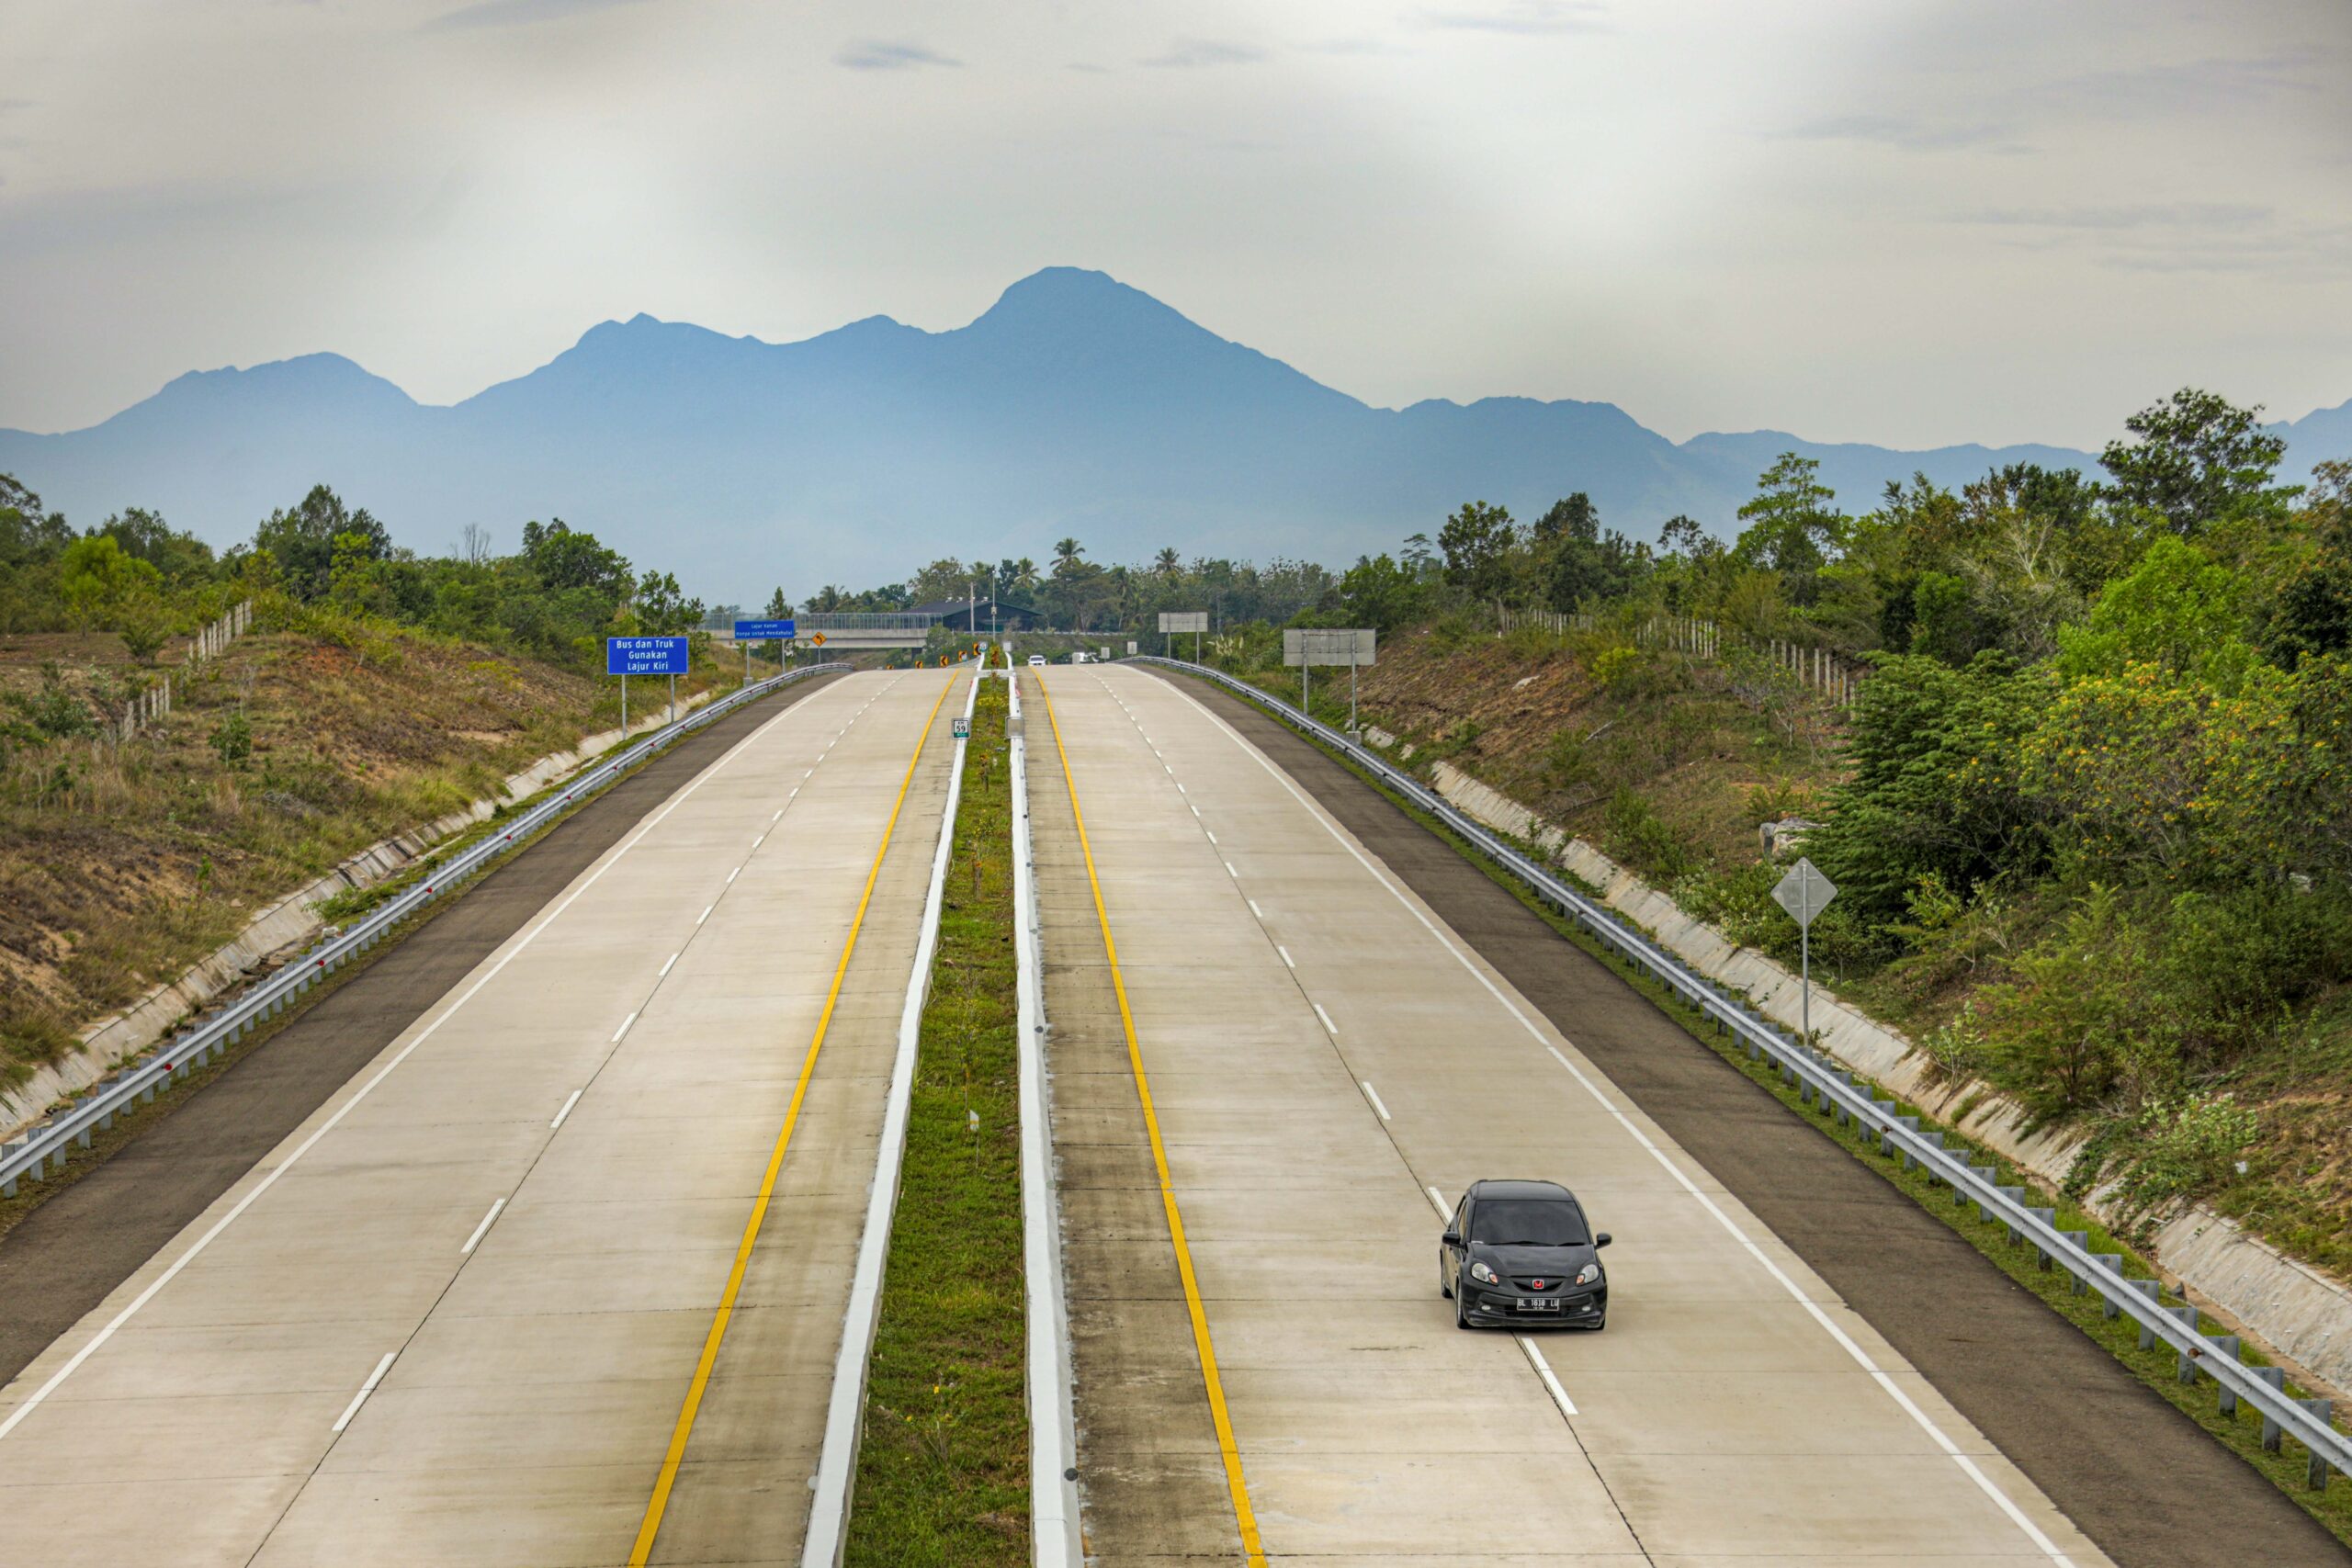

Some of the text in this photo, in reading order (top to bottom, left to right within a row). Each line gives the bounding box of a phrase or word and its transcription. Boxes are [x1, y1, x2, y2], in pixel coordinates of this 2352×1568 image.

[616, 639, 674, 649] Bus dan Truk
[628, 650, 667, 660] Gunakan
[628, 661, 669, 672] Lajur Kiri
